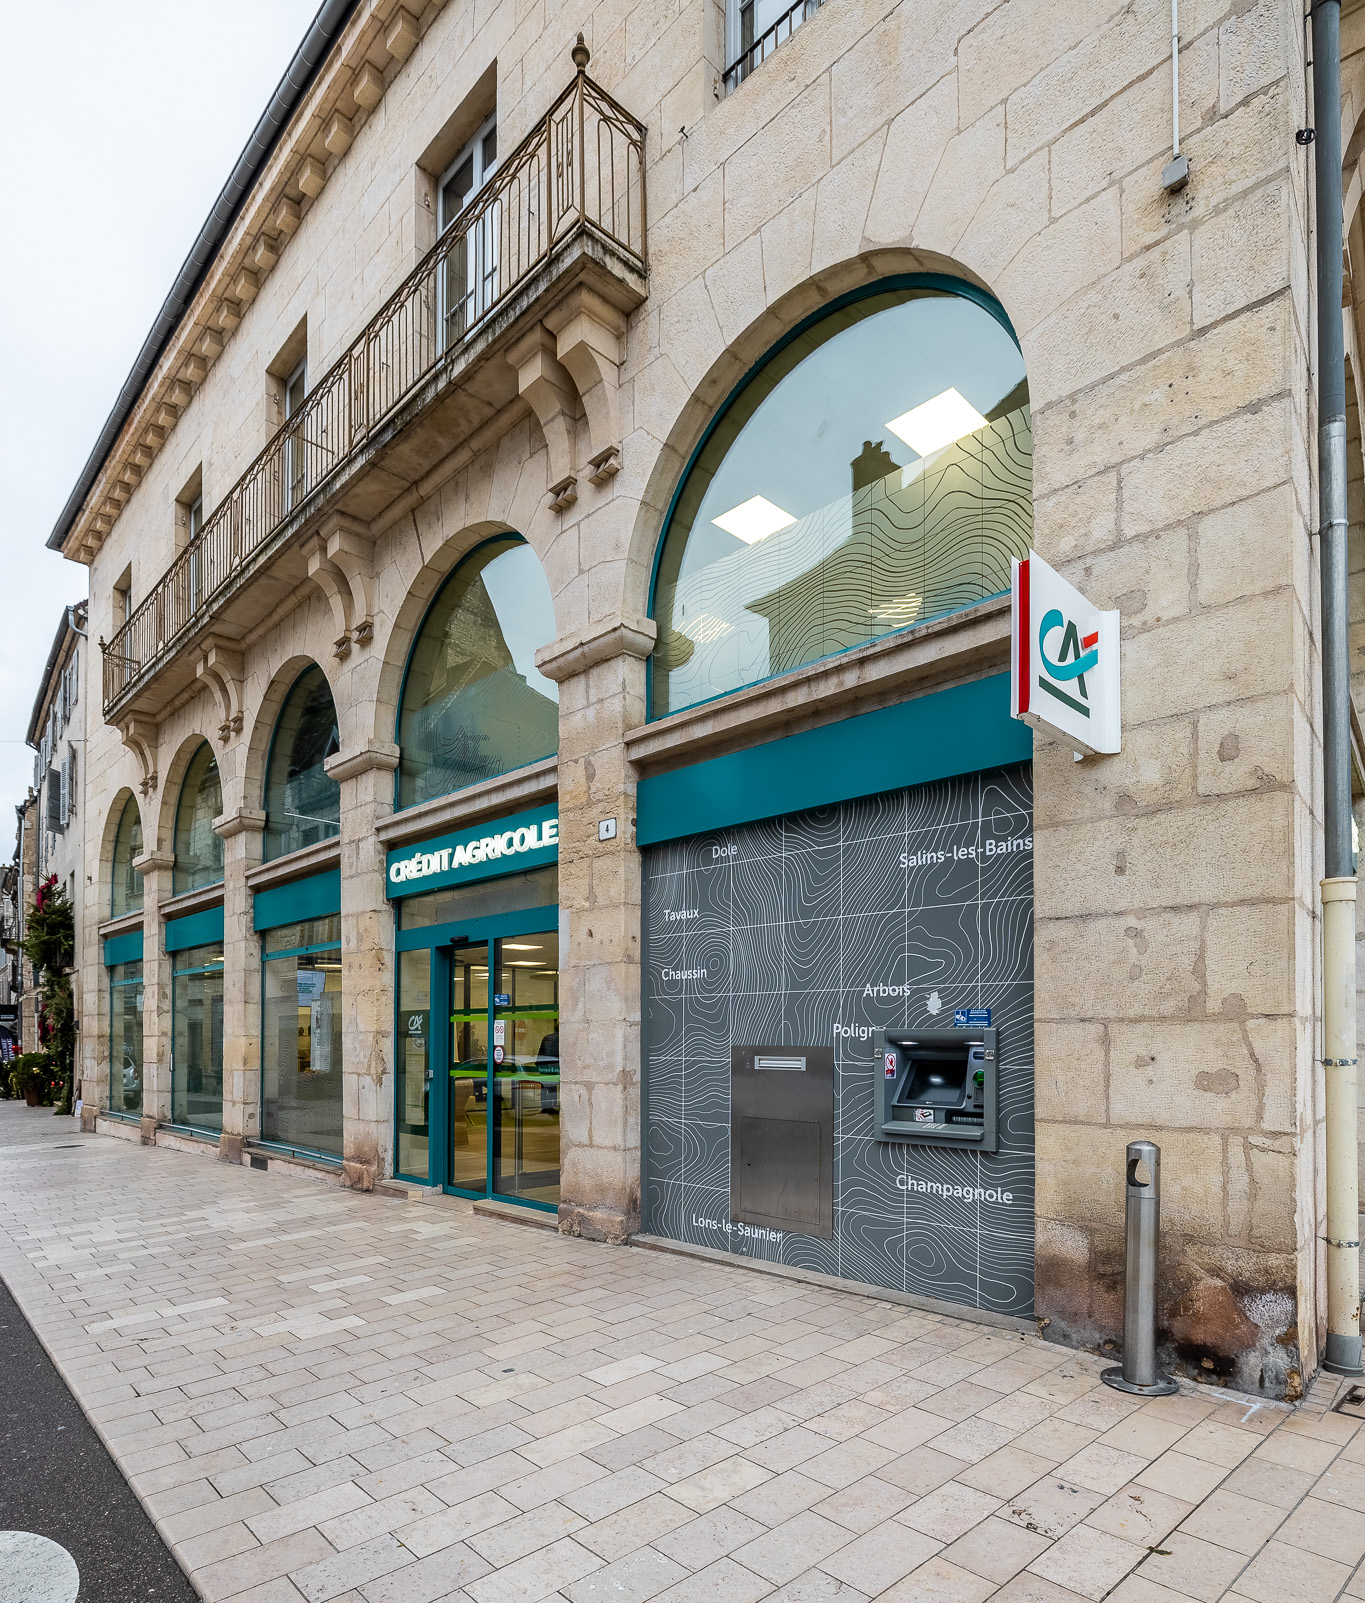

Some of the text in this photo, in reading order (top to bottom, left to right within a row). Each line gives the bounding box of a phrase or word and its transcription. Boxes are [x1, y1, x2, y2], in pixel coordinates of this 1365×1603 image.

[389, 819, 559, 883] CRÉDIT AGRICOLE
[712, 844, 738, 859] Dole
[900, 837, 1033, 868] Salins-les-Bains
[664, 909, 699, 922] Tavaux
[661, 966, 707, 981] Chaussin
[863, 983, 911, 998] Arbois
[833, 1023, 887, 1041] Polign
[896, 1174, 1013, 1205] Champagnole
[692, 1213, 782, 1243] Lons-le-Saunier
